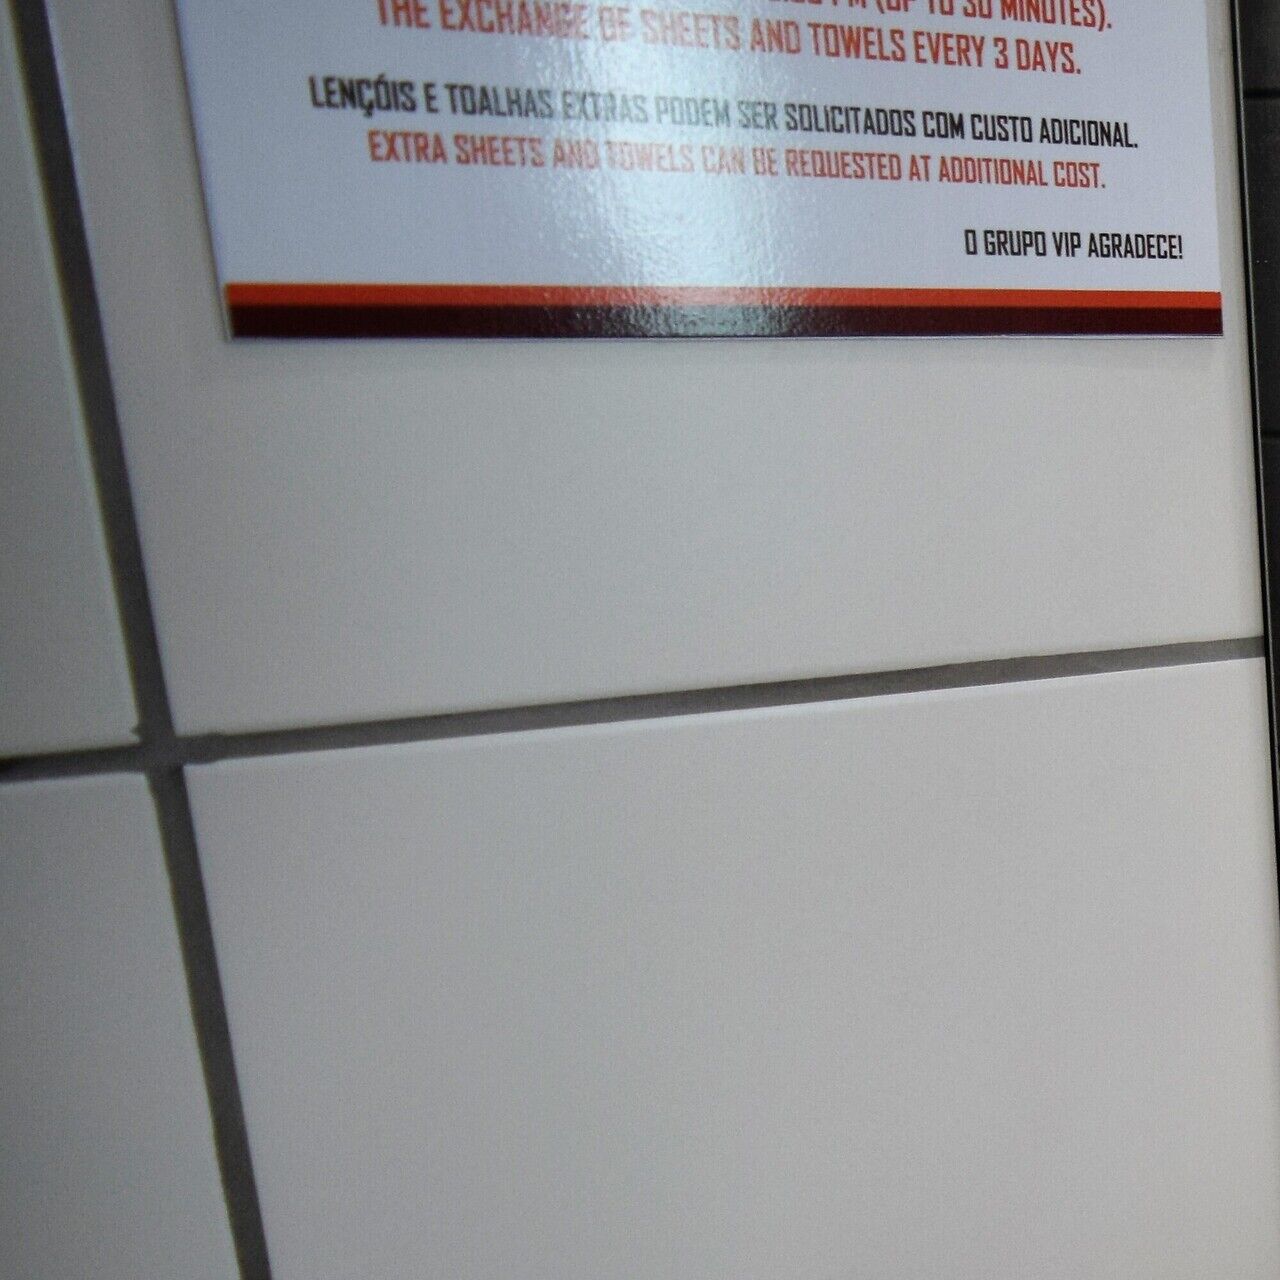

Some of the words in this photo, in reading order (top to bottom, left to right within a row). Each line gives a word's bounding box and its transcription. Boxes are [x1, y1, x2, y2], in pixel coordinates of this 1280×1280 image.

[438, 0, 588, 40] EXCHANGE
[599, 6, 632, 42] OF
[640, 9, 741, 51] SHEETS
[750, 18, 801, 54] AND
[807, 22, 906, 62] TOWELS
[912, 30, 985, 68] EVERY
[993, 37, 1009, 70] 3
[1015, 39, 1082, 75] DAYS.
[308, 73, 418, 119] LENÇÓIS
[423, 82, 440, 114] E
[444, 83, 555, 119] TOALHAS
[561, 90, 650, 124] EXTRAS
[654, 95, 732, 128] PODEM
[737, 99, 779, 131] SER
[784, 103, 917, 137] SOLICITADOS
[921, 110, 966, 140] COM
[970, 113, 1033, 143] CUSTO
[1039, 117, 1139, 149] ADICIONAL.
[367, 129, 449, 164] EXTRA
[453, 132, 545, 169] SHEETS
[552, 137, 599, 171] AND
[604, 139, 695, 174] TOWELS
[701, 144, 747, 176] CAN
[752, 147, 778, 178] BE
[785, 148, 902, 181] REQUESTED
[909, 154, 931, 182] AT
[939, 156, 1049, 187] ADDITIONAL
[1053, 161, 1106, 189] COST.
[964, 229, 978, 256] O
[983, 229, 1048, 257] GRUPO
[1052, 231, 1082, 258] VIP
[1088, 232, 1184, 260] AGRADECE!
